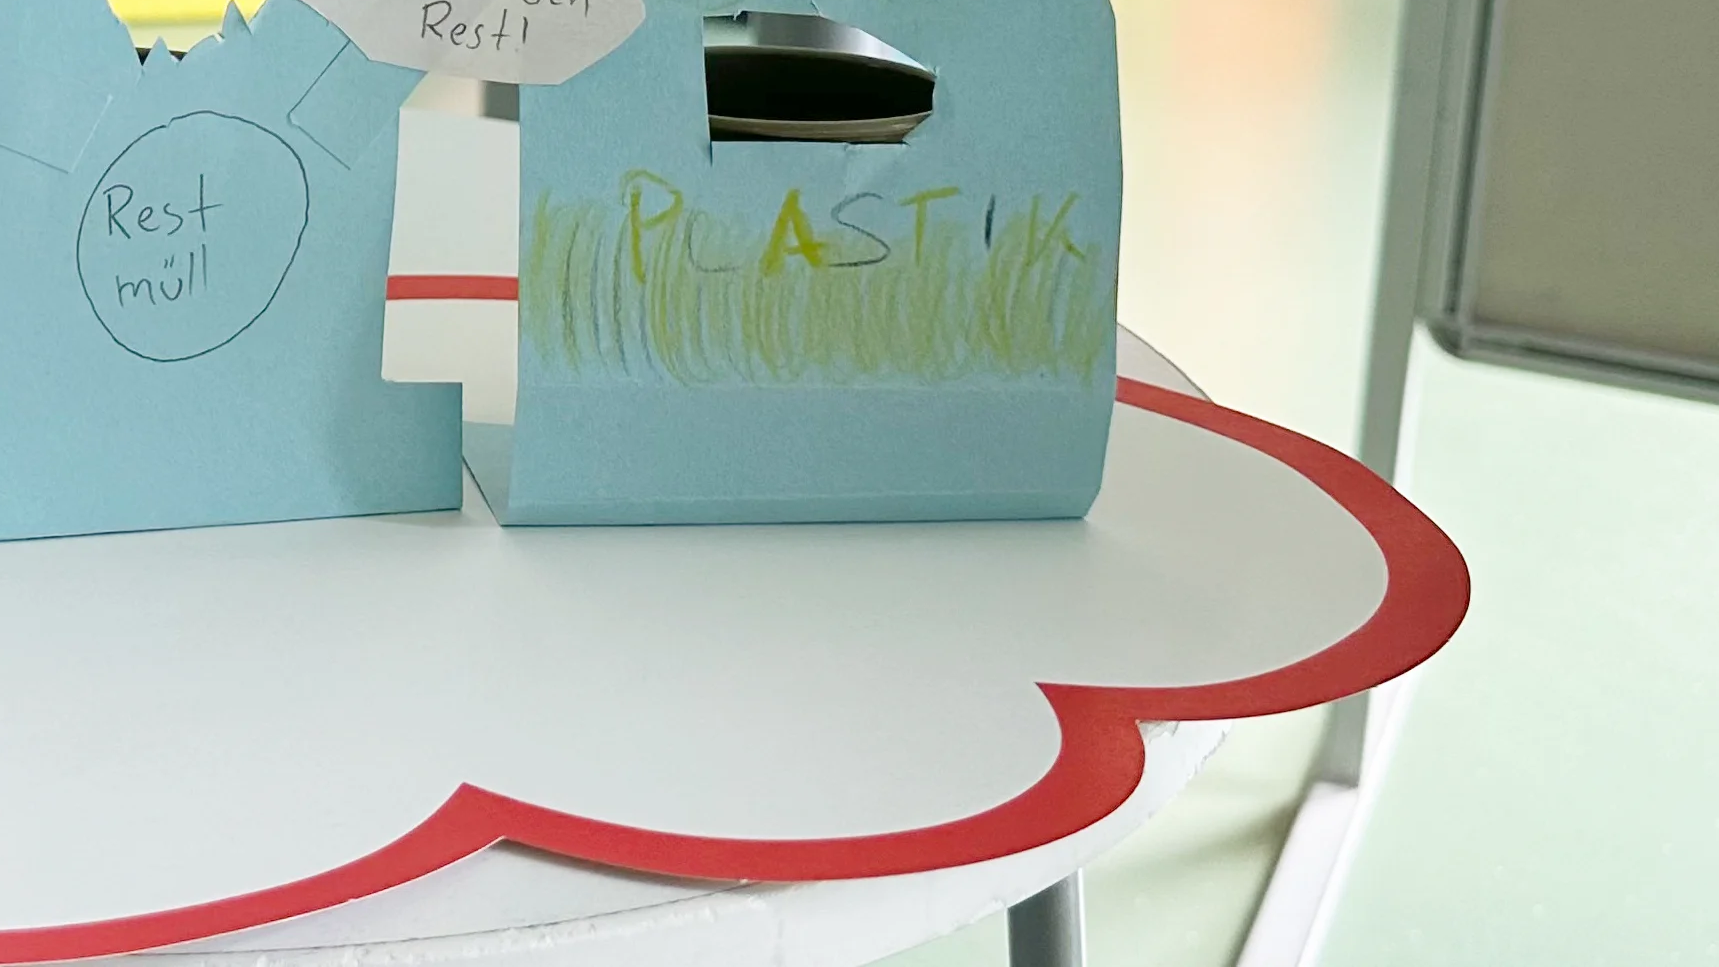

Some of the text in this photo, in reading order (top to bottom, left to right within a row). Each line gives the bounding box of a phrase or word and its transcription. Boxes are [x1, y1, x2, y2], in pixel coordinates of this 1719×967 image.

[420, 0, 529, 53] Rest!
[102, 173, 224, 240] Rest
[618, 168, 1087, 285] PLASTIK
[115, 243, 208, 308] müll
